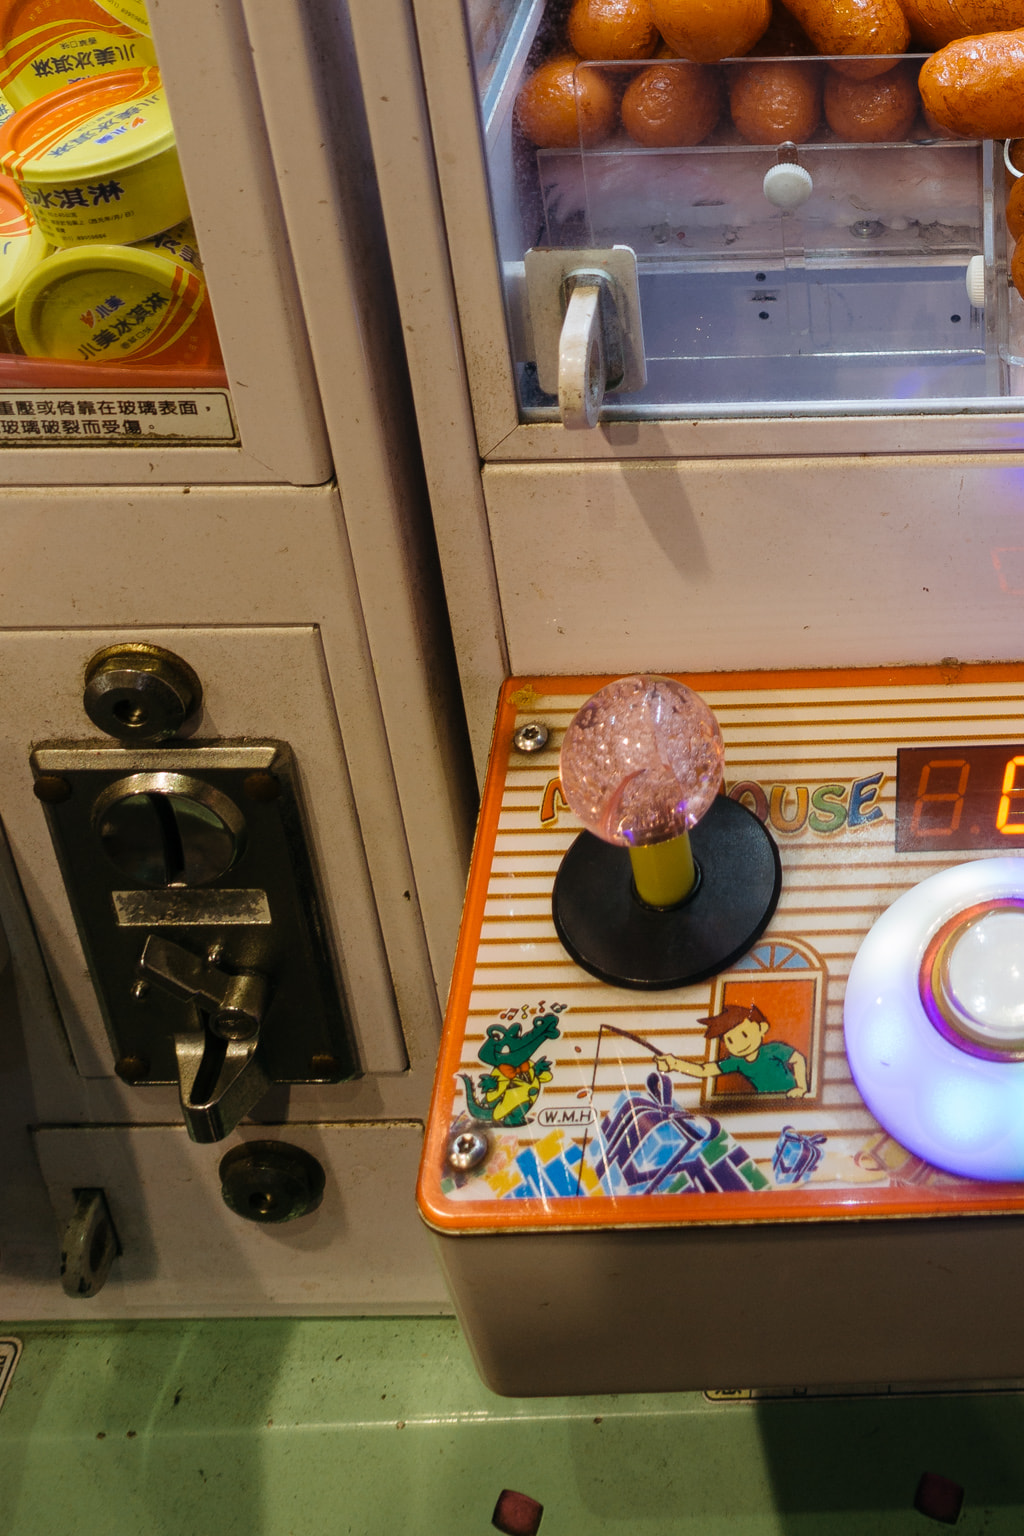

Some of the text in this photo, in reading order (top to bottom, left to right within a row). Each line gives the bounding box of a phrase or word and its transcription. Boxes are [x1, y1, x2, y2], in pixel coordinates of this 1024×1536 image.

[31, 44, 135, 78] 小美冰淇淋
[78, 291, 169, 360] 小美冰淇淋
[721, 772, 884, 835] OUSE
[545, 1110, 592, 1123] W.M.H
